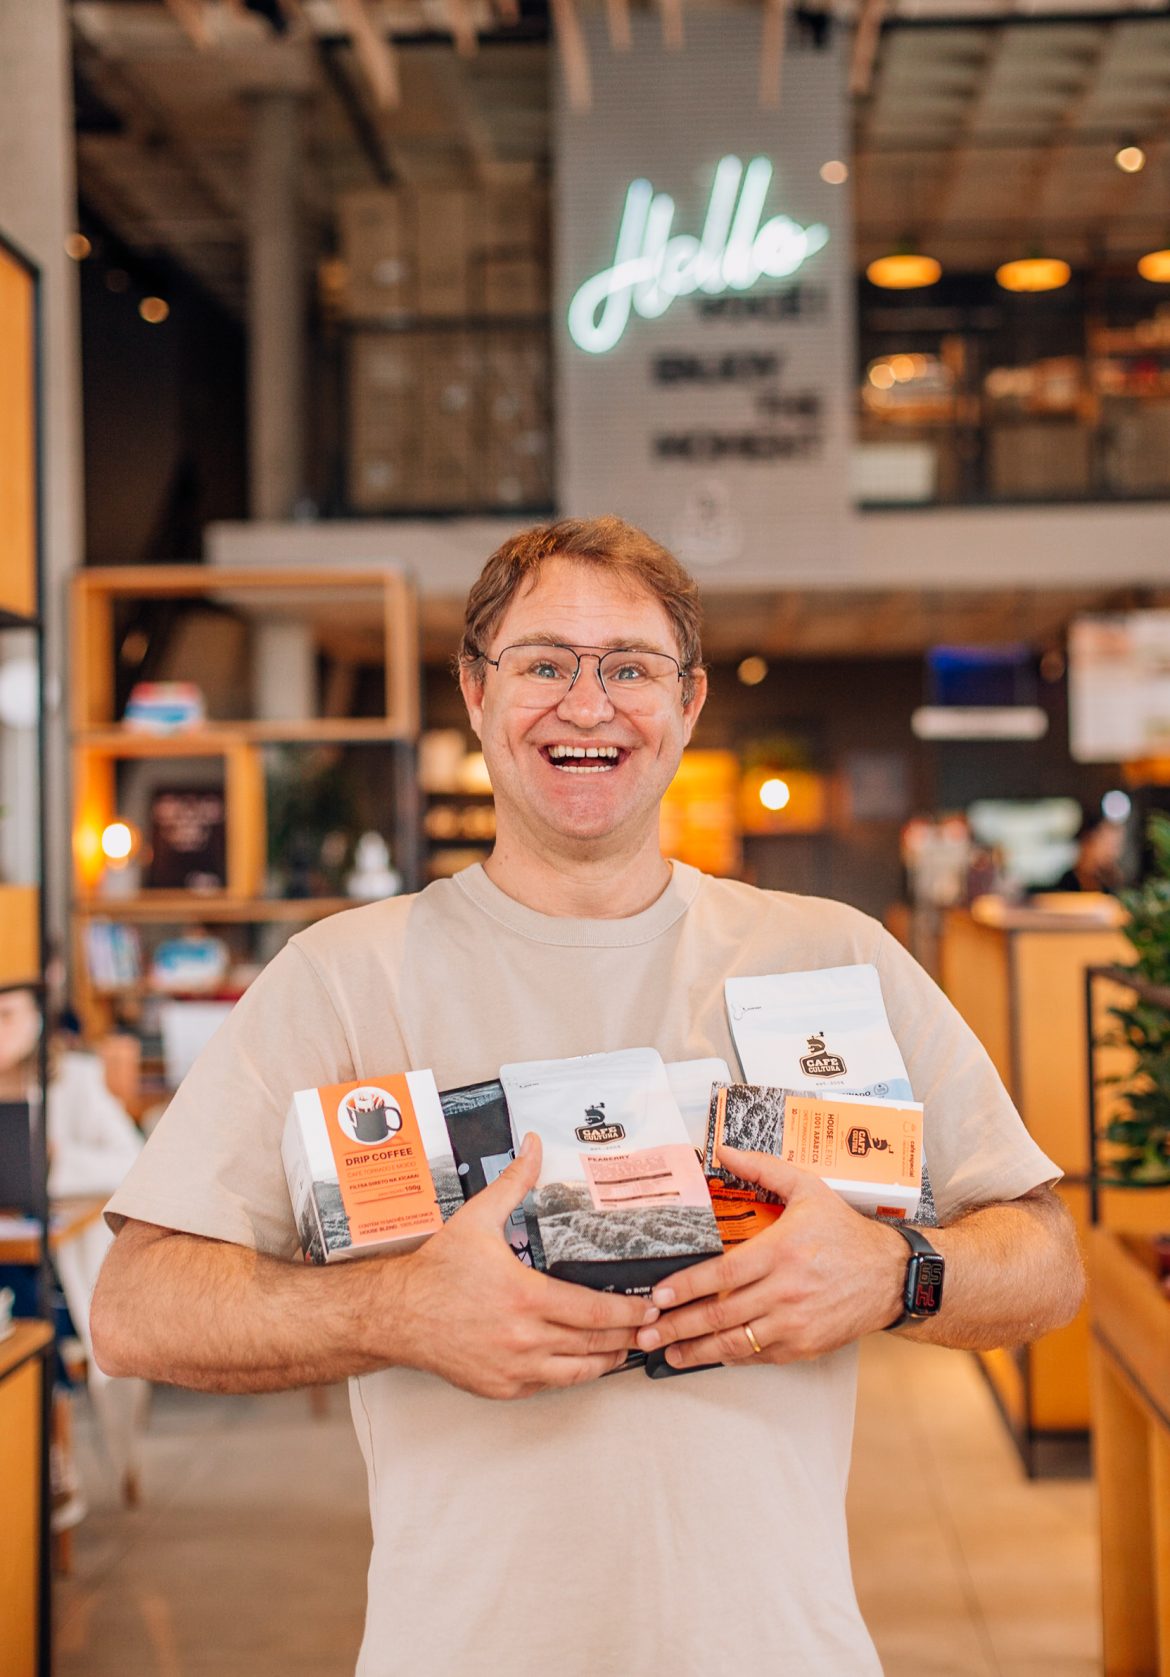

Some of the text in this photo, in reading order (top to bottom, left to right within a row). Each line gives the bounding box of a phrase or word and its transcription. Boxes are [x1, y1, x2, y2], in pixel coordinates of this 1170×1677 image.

[567, 154, 831, 354] Hello
[808, 1065, 841, 1074] CULTURA
[345, 1147, 413, 1166] DRIP COFFEE
